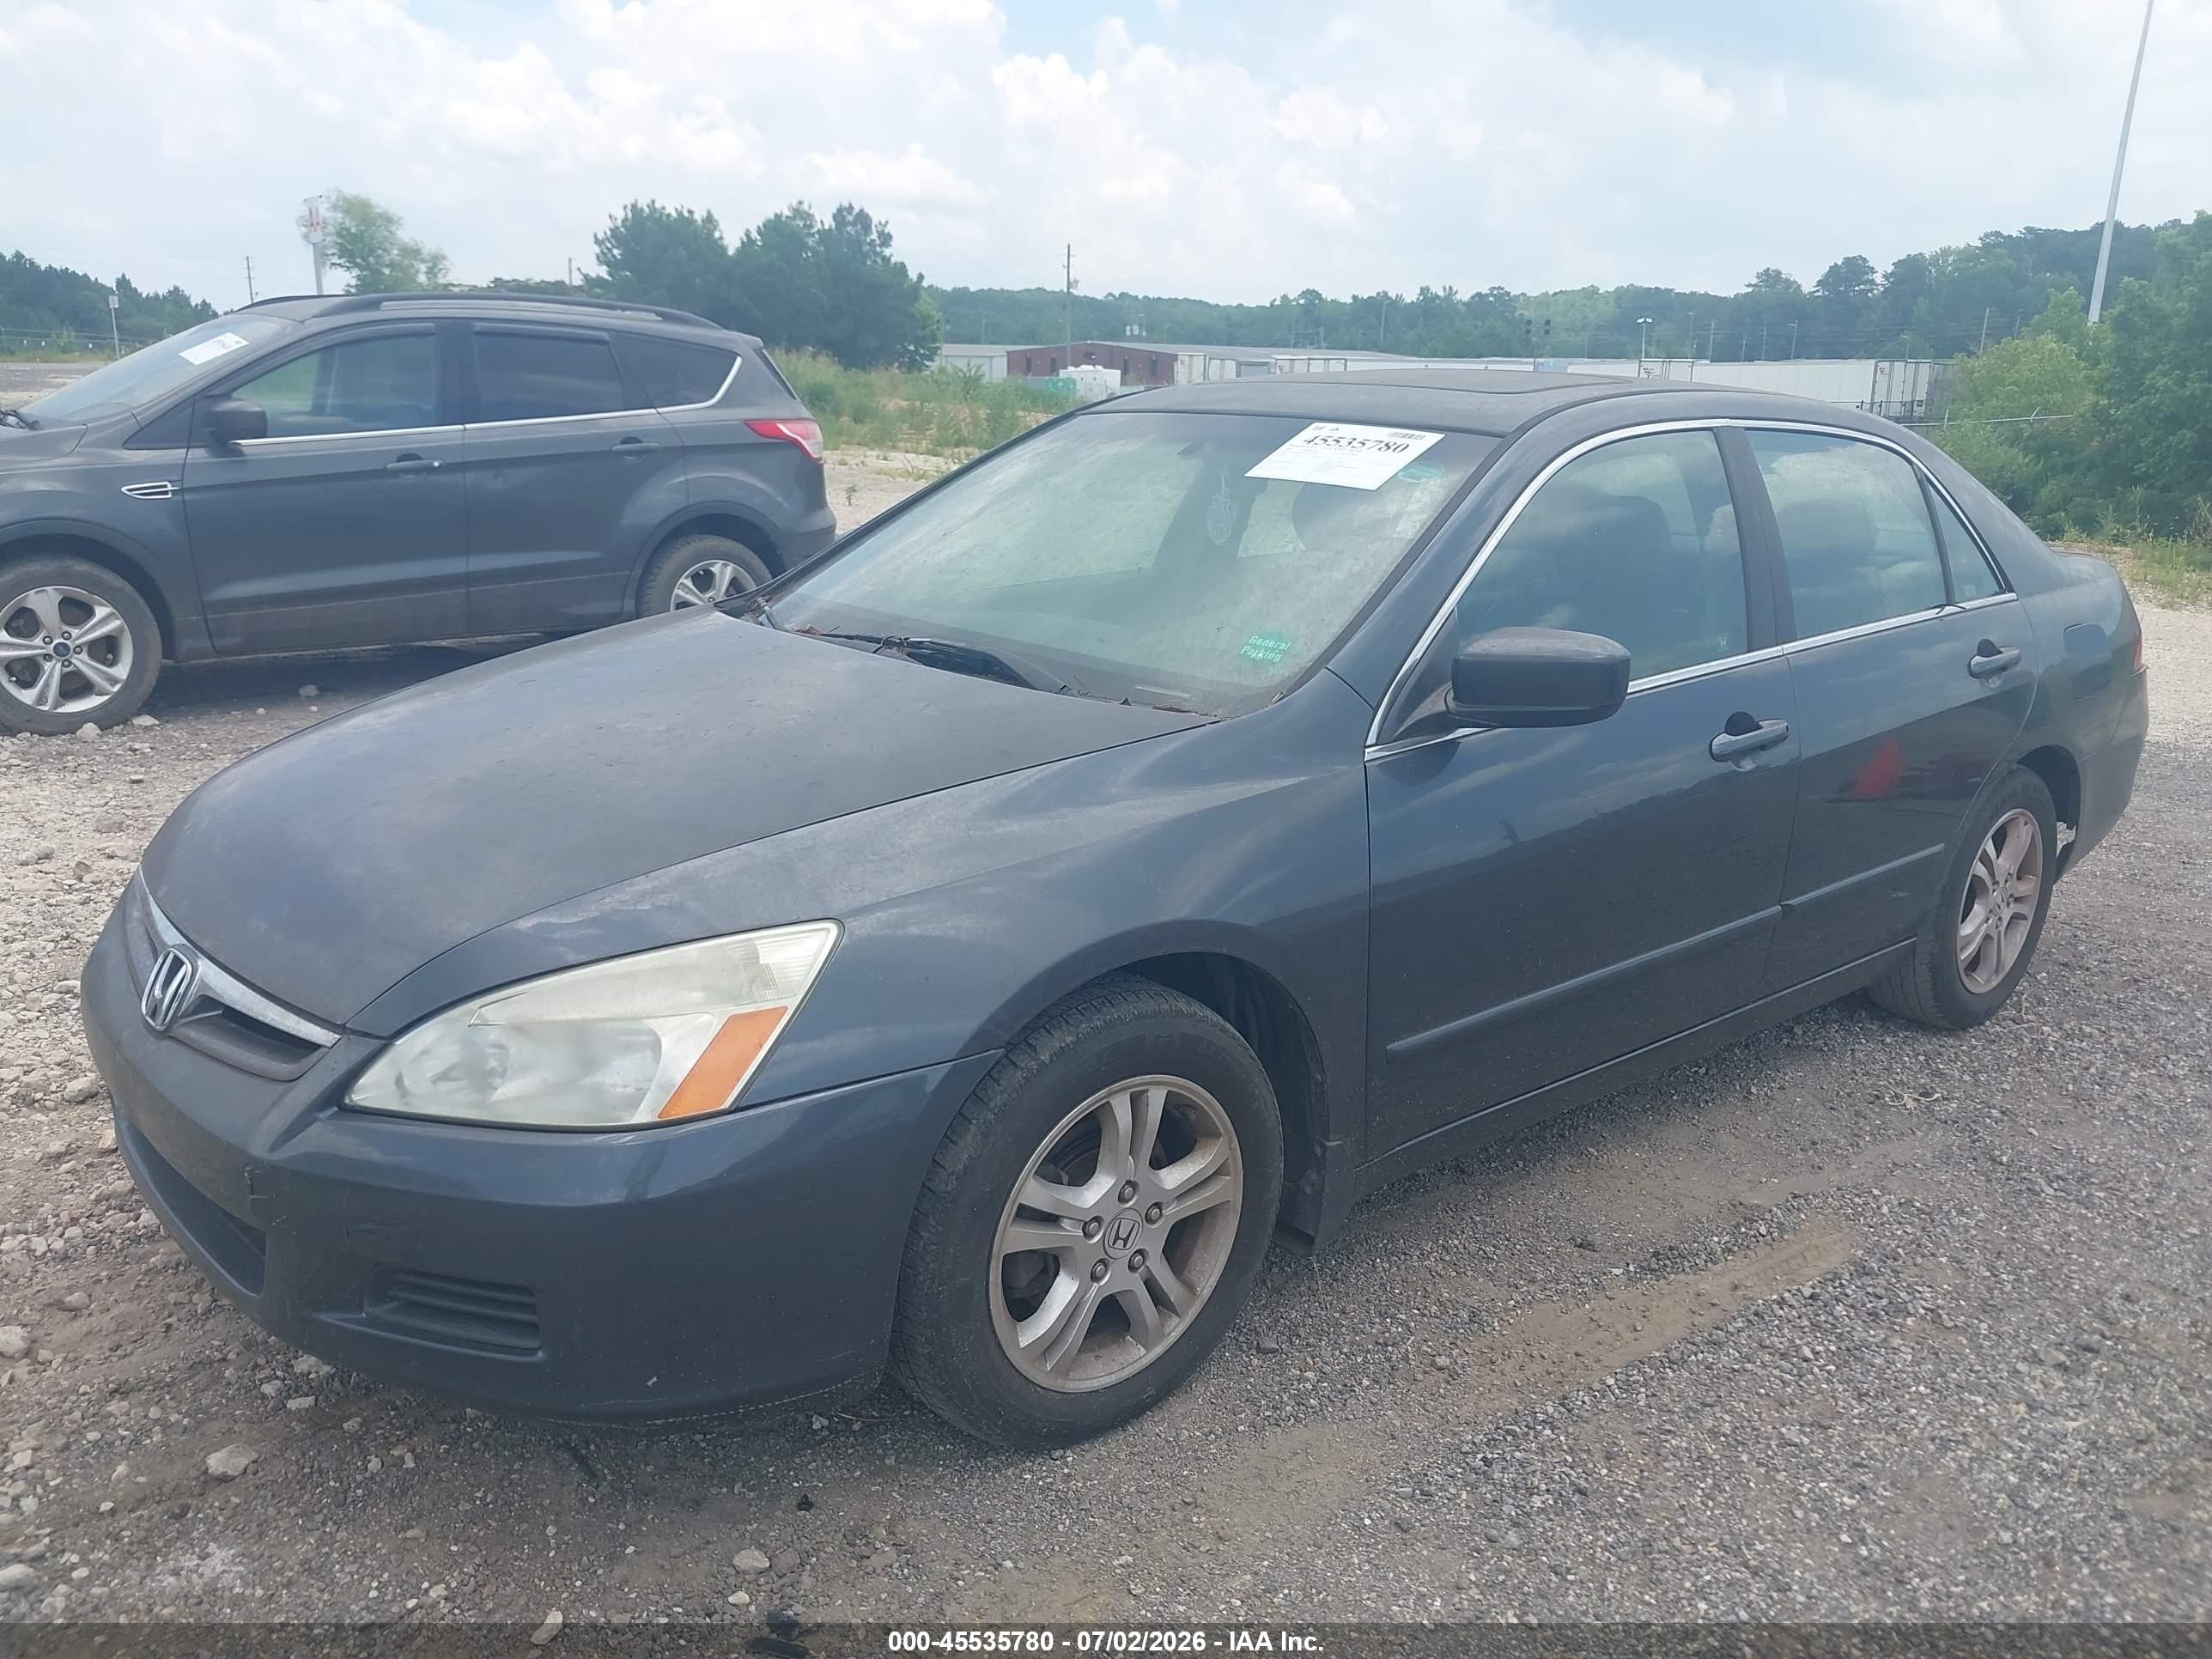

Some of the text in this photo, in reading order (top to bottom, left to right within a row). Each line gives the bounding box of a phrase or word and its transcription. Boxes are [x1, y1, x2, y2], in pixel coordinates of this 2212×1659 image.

[1303, 434, 1410, 453] 45535780
[1249, 635, 1291, 651] General
[1240, 645, 1283, 662] Parking
